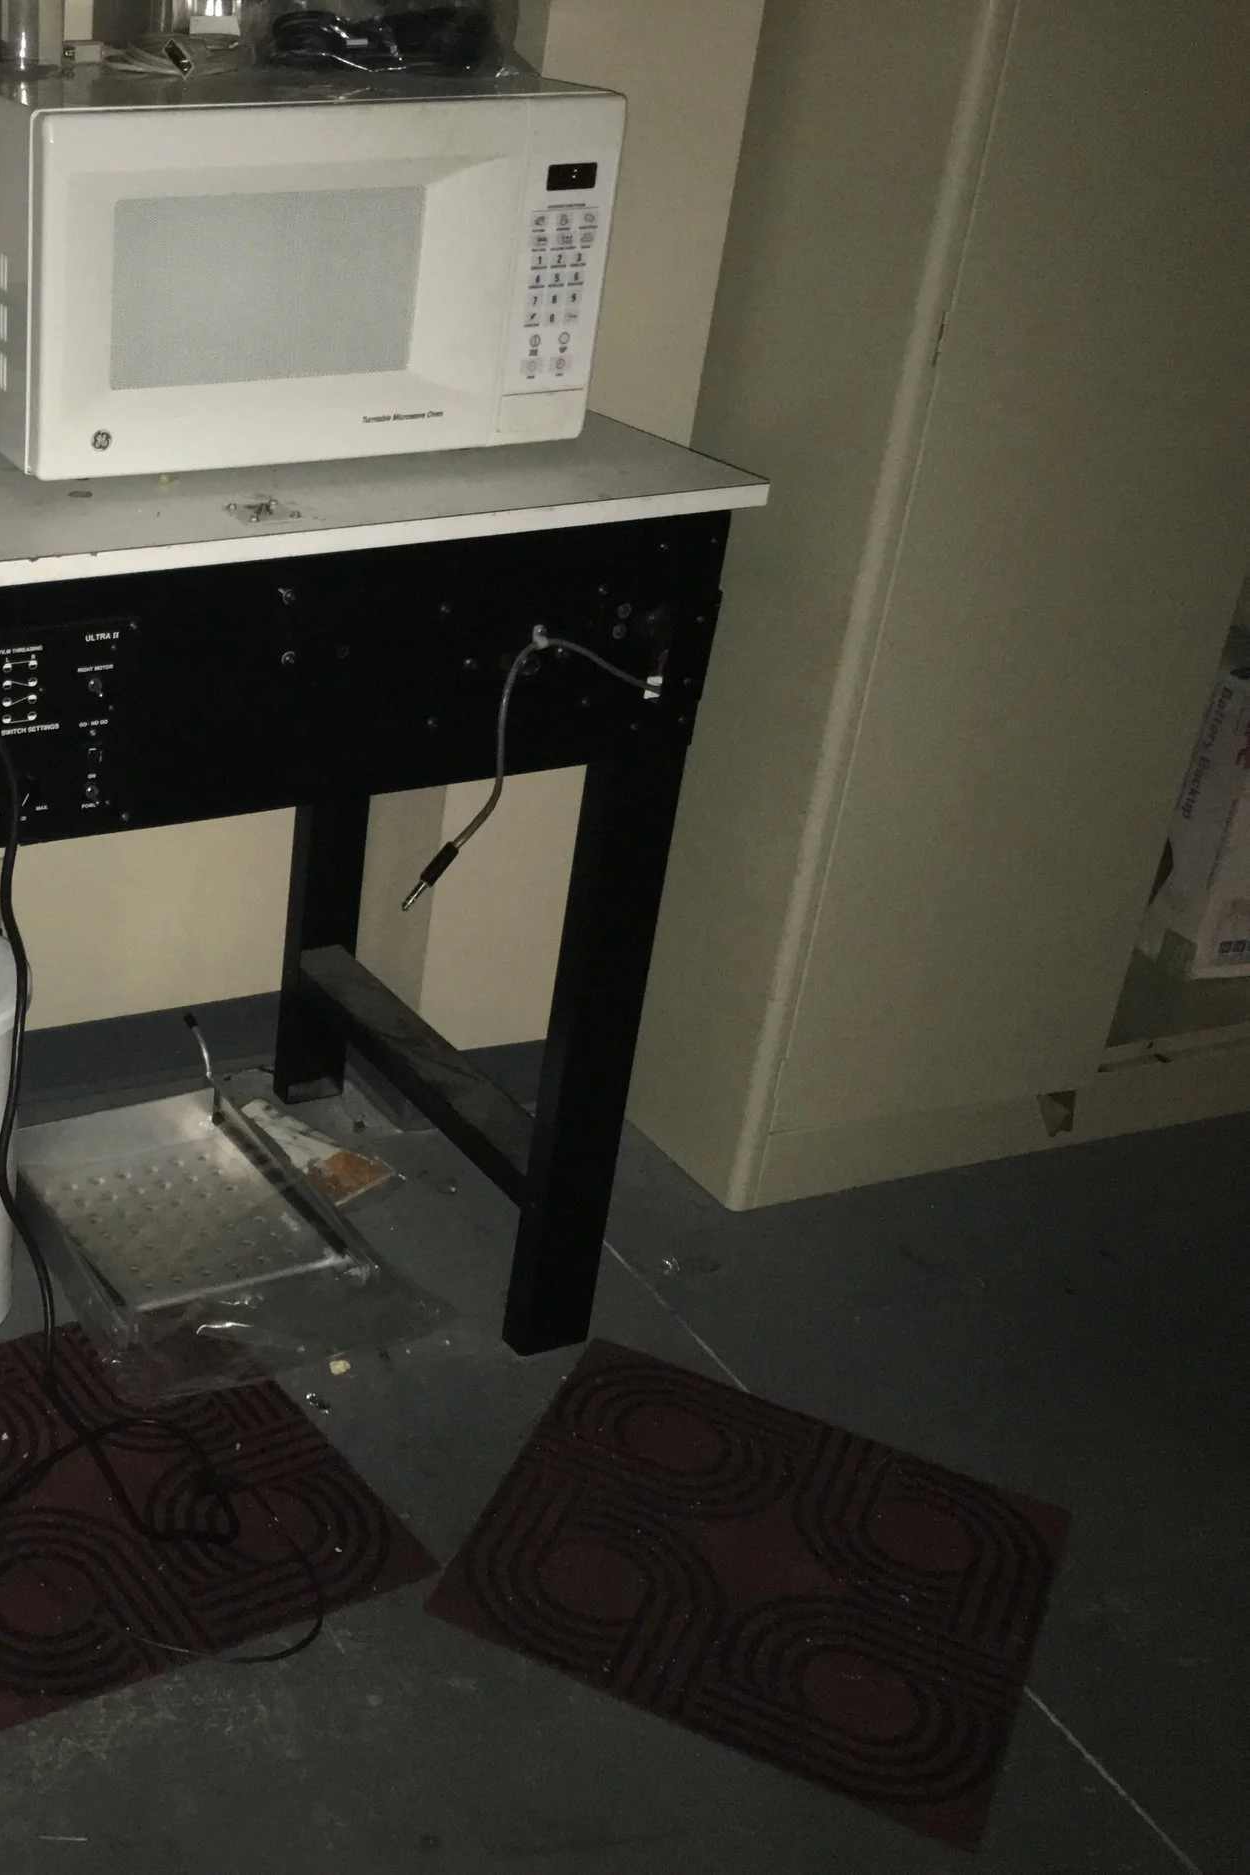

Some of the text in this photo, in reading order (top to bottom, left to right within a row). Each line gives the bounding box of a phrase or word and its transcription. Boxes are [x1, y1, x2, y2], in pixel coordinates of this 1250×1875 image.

[85, 632, 111, 642] ULTRA
[1, 727, 27, 736] SWITCH
[28, 723, 60, 733] SETTINGS
